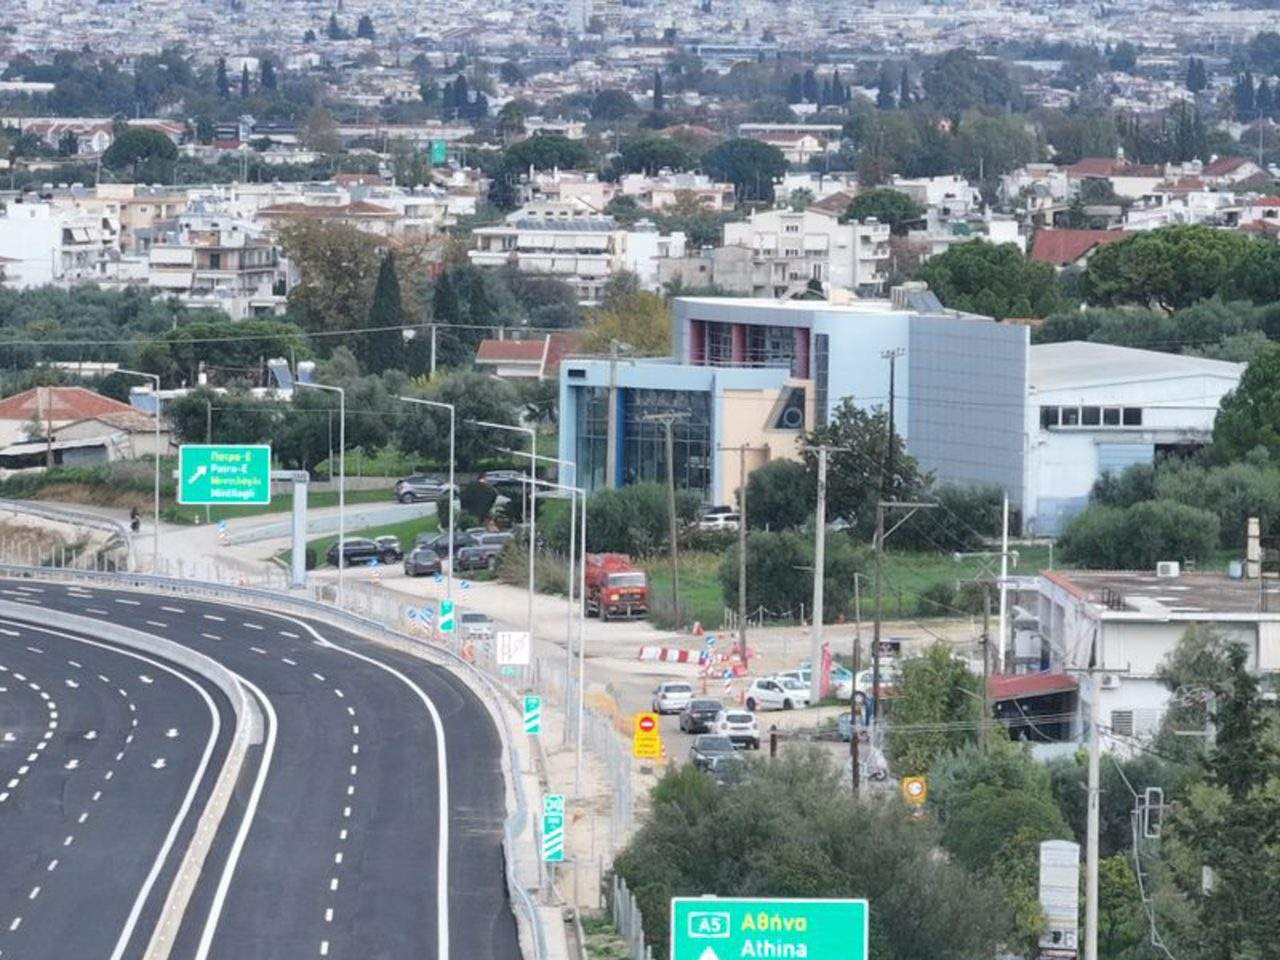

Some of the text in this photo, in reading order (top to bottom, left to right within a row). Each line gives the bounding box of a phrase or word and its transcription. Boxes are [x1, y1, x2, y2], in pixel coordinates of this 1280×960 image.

[699, 917, 721, 932] A5
[741, 912, 807, 931] Αθήνα
[741, 939, 807, 958] Athina
